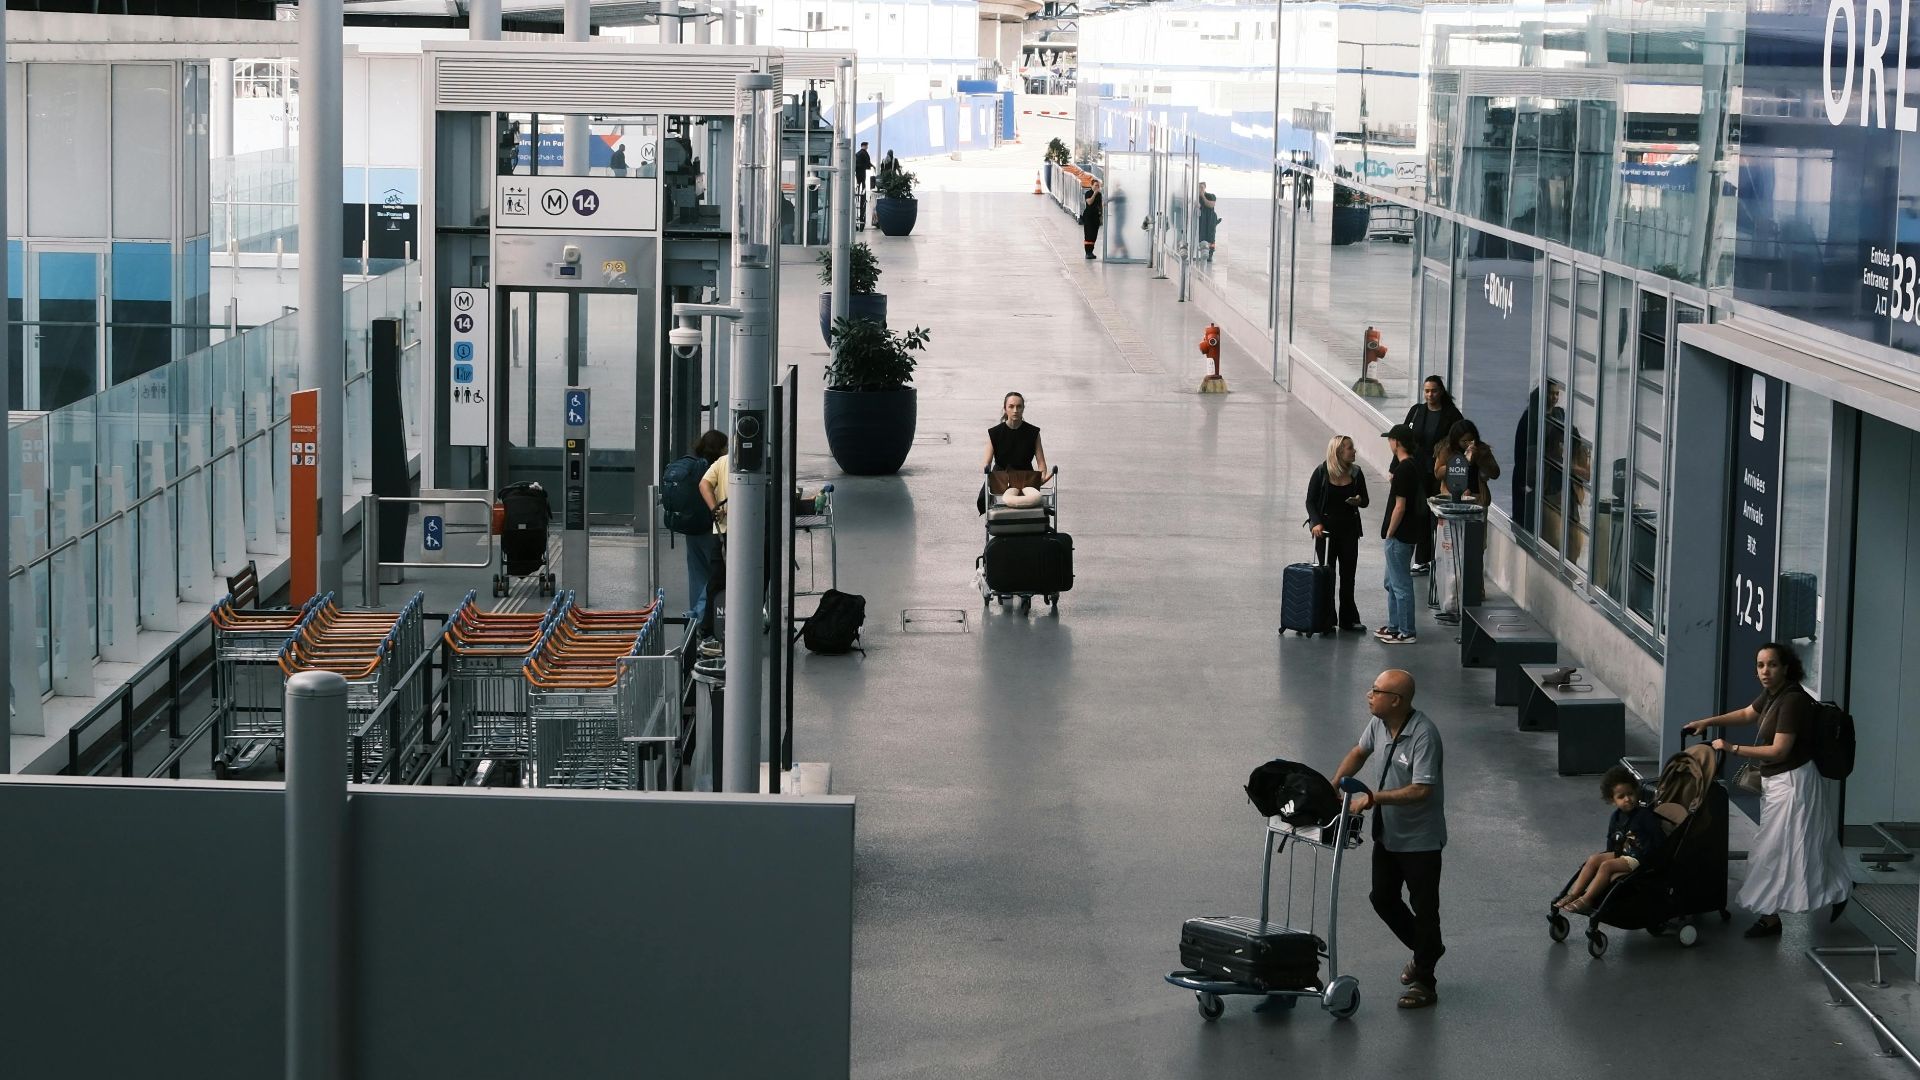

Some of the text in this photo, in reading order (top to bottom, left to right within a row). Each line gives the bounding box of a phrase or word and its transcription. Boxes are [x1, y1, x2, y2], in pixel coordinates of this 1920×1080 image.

[1823, 0, 1918, 132] ORL
[547, 194, 596, 211] M 14
[1871, 247, 1890, 267] Entrée
[1863, 268, 1889, 290] Entrance
[458, 295, 470, 307] M
[1874, 294, 1888, 316] 入口
[456, 317, 472, 329] 14
[1744, 467, 1766, 494] Arrivées
[1743, 500, 1764, 526] Arrivals
